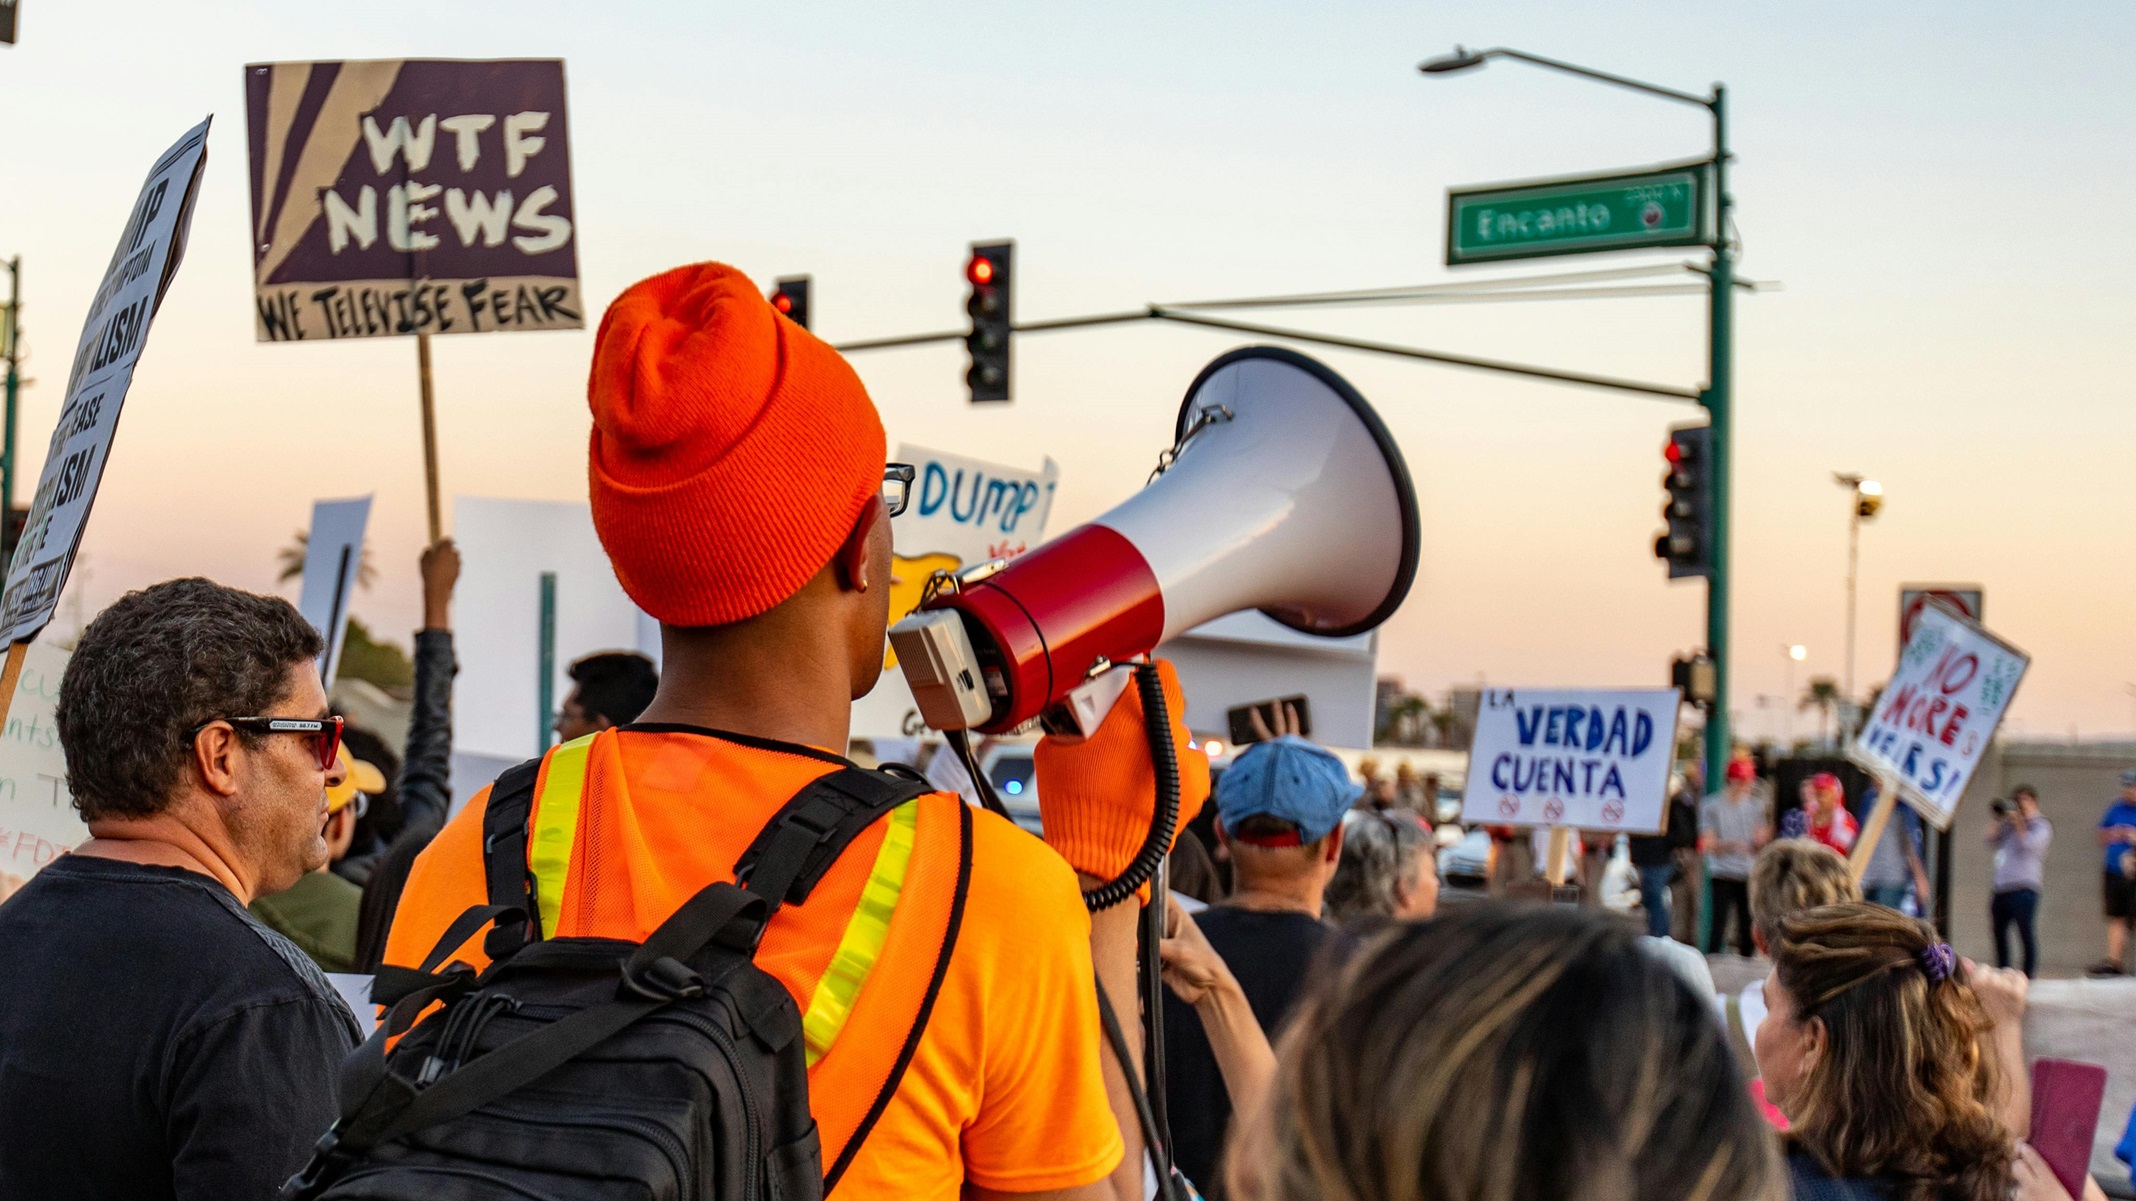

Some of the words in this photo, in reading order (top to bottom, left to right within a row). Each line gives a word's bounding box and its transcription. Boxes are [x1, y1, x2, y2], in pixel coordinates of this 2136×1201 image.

[362, 111, 550, 178] WTF
[324, 180, 572, 256] NEWS
[1477, 201, 1611, 242] Encanto
[257, 289, 306, 341] WE
[311, 283, 453, 339] TELEVISE
[462, 278, 582, 331] FEAR
[918, 460, 1039, 533] DUMP
[1488, 688, 1516, 709] LA
[1923, 644, 1980, 695] NO
[1516, 704, 1654, 759] VERDAD
[1881, 684, 1969, 747] MORE
[1491, 752, 1627, 799] CUENTA
